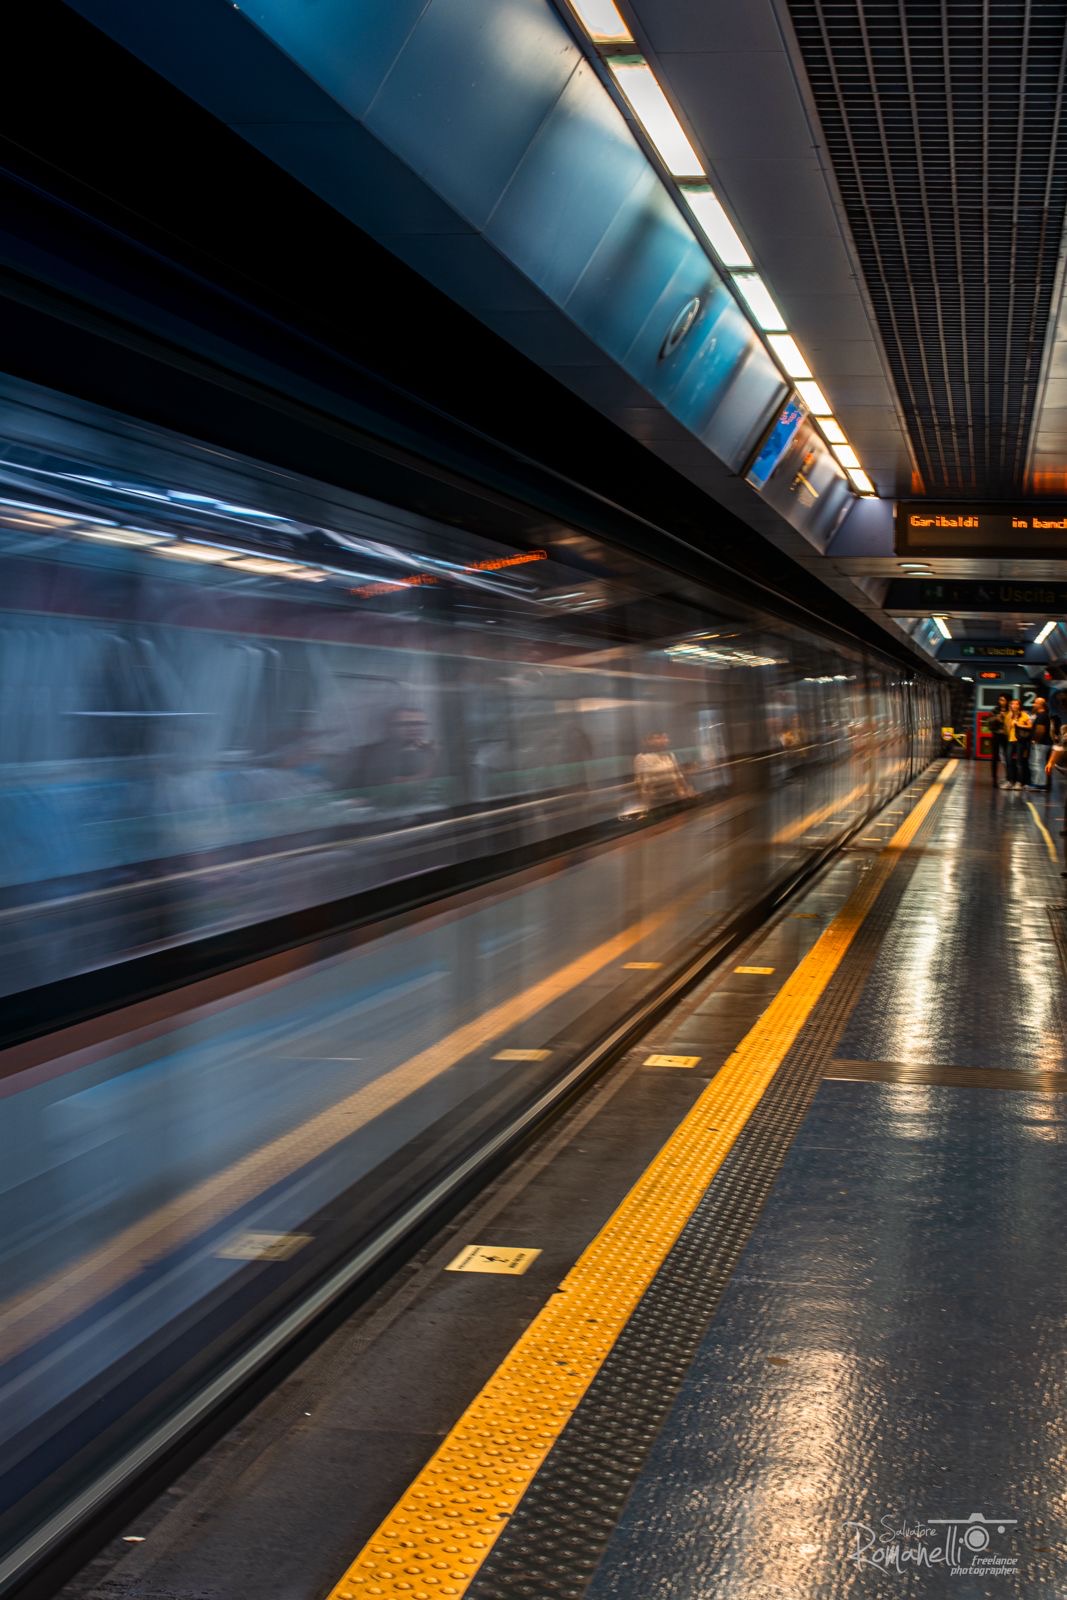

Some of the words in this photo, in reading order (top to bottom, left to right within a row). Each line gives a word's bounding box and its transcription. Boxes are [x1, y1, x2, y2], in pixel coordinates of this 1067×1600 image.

[910, 515, 979, 528] Garibaldi
[1012, 517, 1028, 528] in
[999, 586, 1056, 604] Uscita
[1023, 691, 1037, 707] 2
